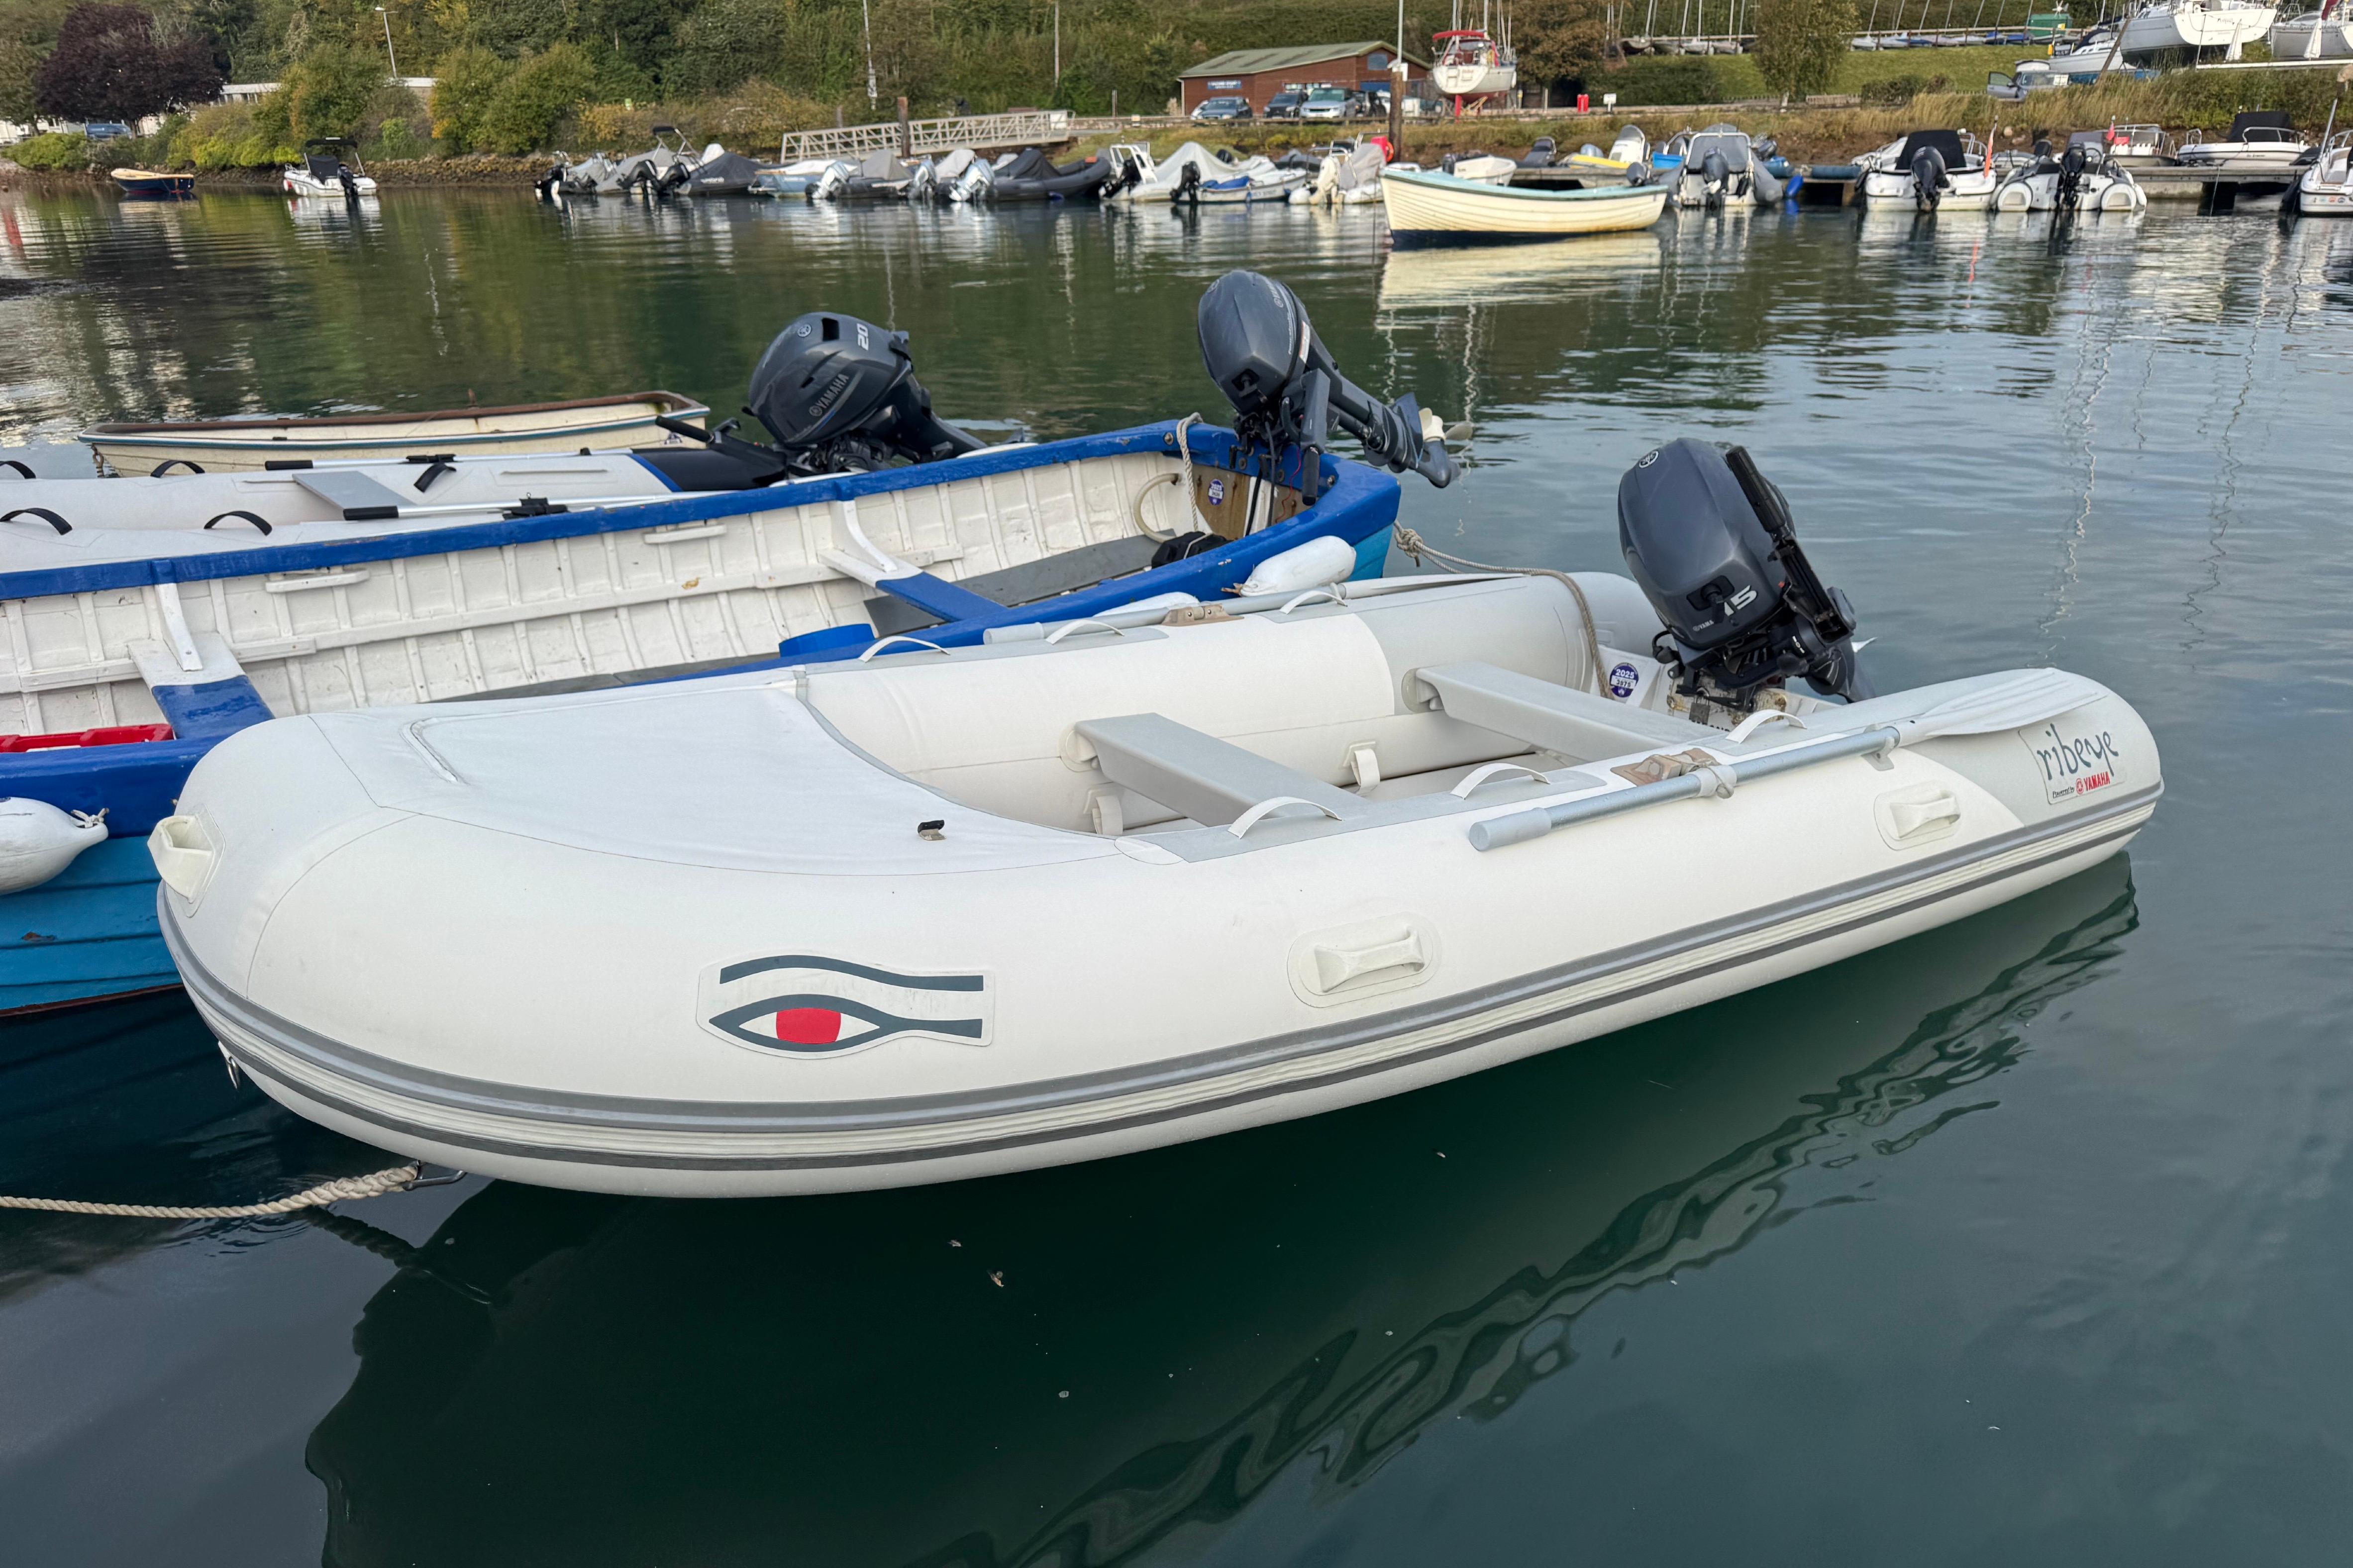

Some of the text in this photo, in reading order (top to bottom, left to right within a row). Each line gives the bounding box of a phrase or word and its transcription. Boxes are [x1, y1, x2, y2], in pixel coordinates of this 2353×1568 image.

[856, 323, 869, 351] 20
[816, 374, 849, 409] YAMAHA
[1698, 620, 1714, 629] YAMA
[1615, 669, 1635, 679] 2025
[2037, 723, 2119, 781] ribeye
[2083, 771, 2110, 791] YAMAHA
